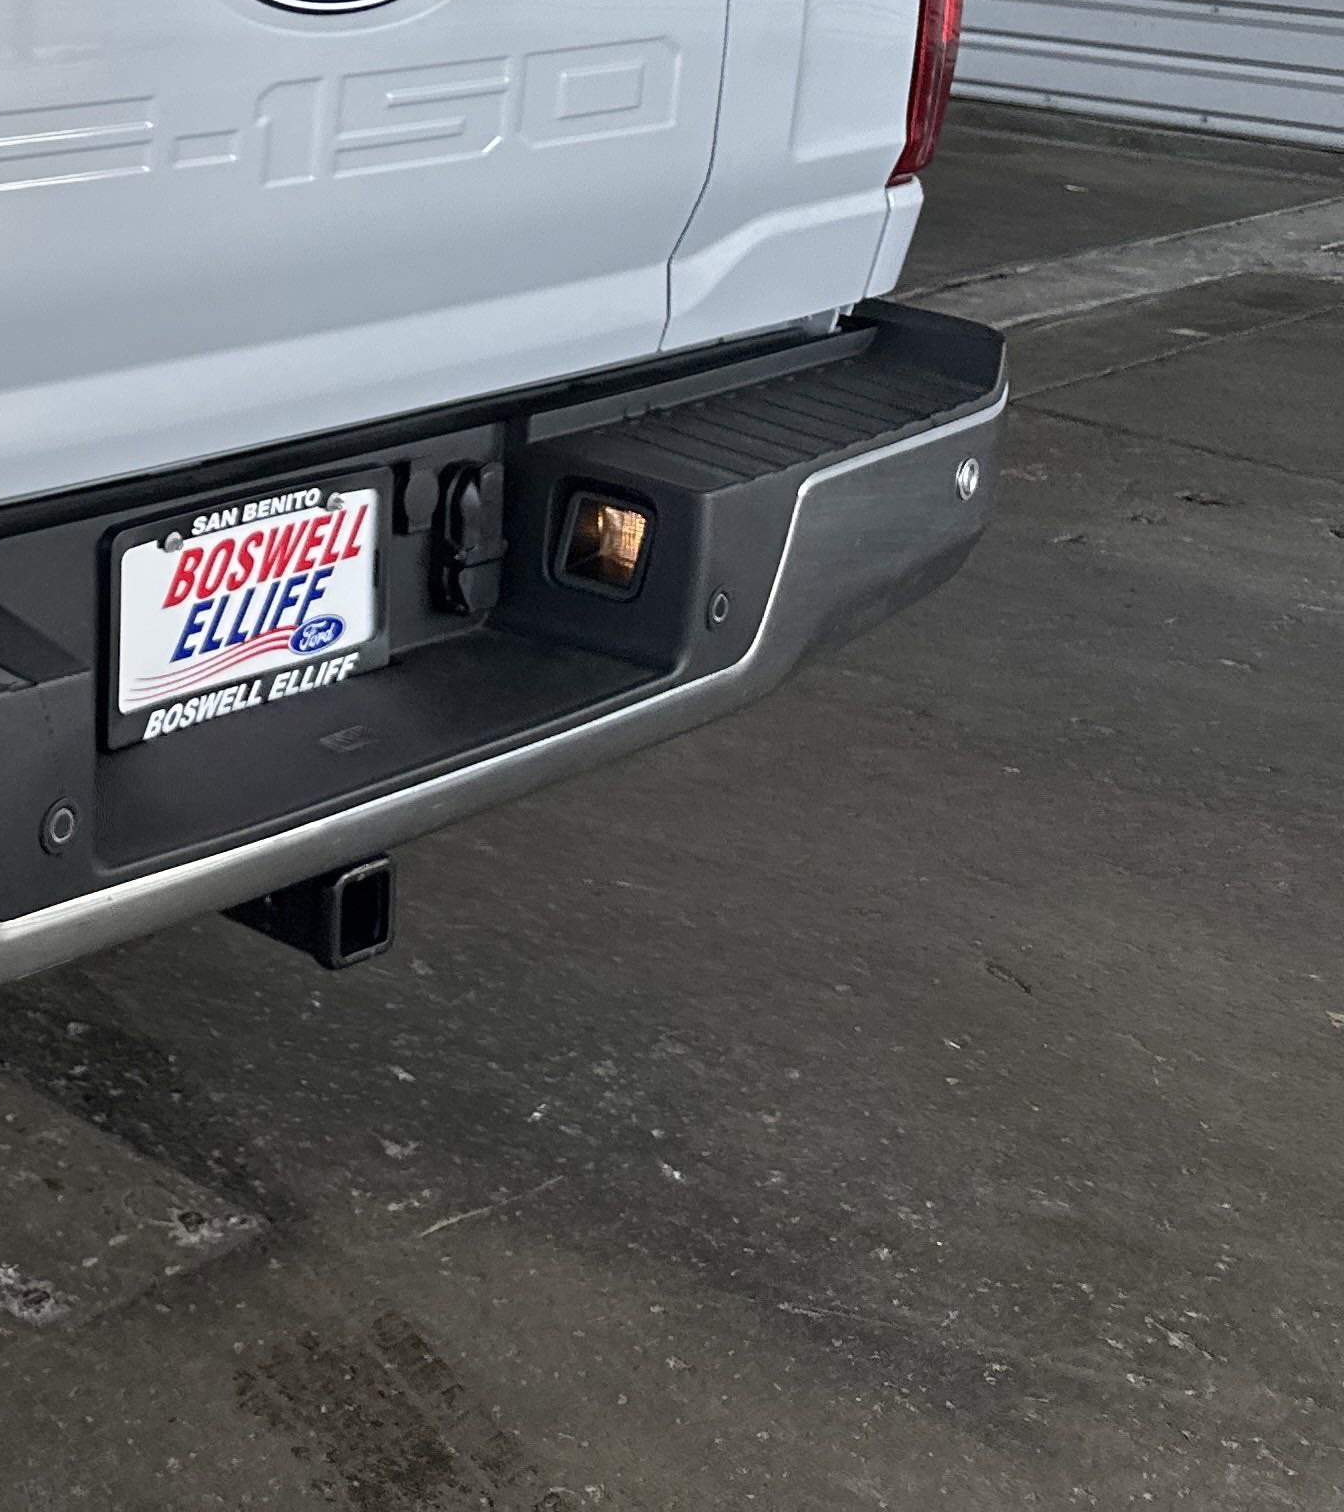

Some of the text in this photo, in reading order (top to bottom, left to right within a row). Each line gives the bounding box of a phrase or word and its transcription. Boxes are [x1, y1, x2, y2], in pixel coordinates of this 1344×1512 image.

[161, 503, 369, 610] BOSWELL
[191, 488, 322, 537] SAN BENITO
[169, 566, 335, 664] ELLIFF
[298, 620, 337, 652] Ford
[142, 652, 361, 741] BOSWELL ELLIFF
